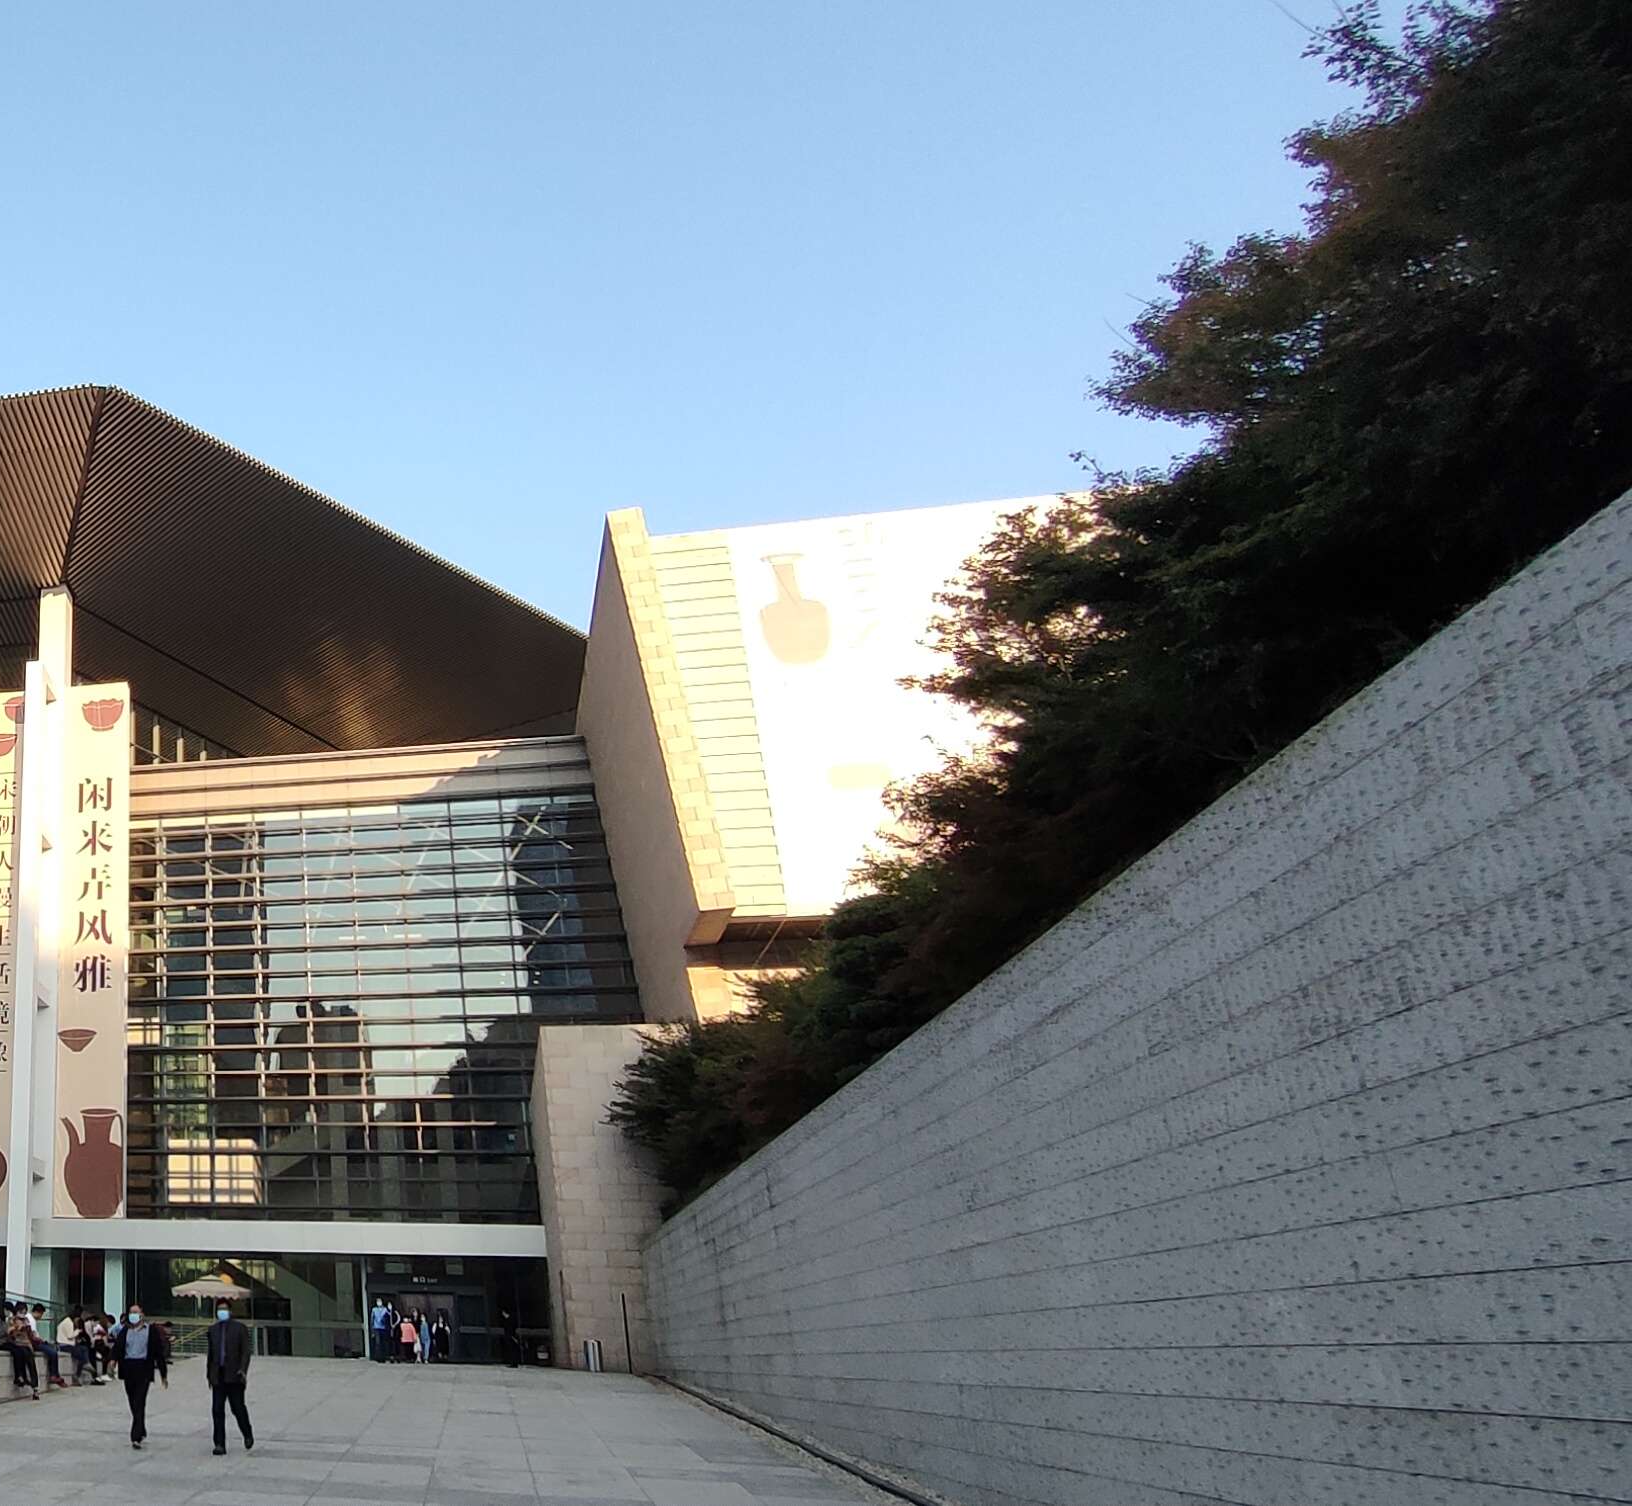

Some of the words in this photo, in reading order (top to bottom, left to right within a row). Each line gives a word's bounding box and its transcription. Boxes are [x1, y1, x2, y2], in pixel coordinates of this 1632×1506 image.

[72, 777, 113, 992] 闲来弄风雅
